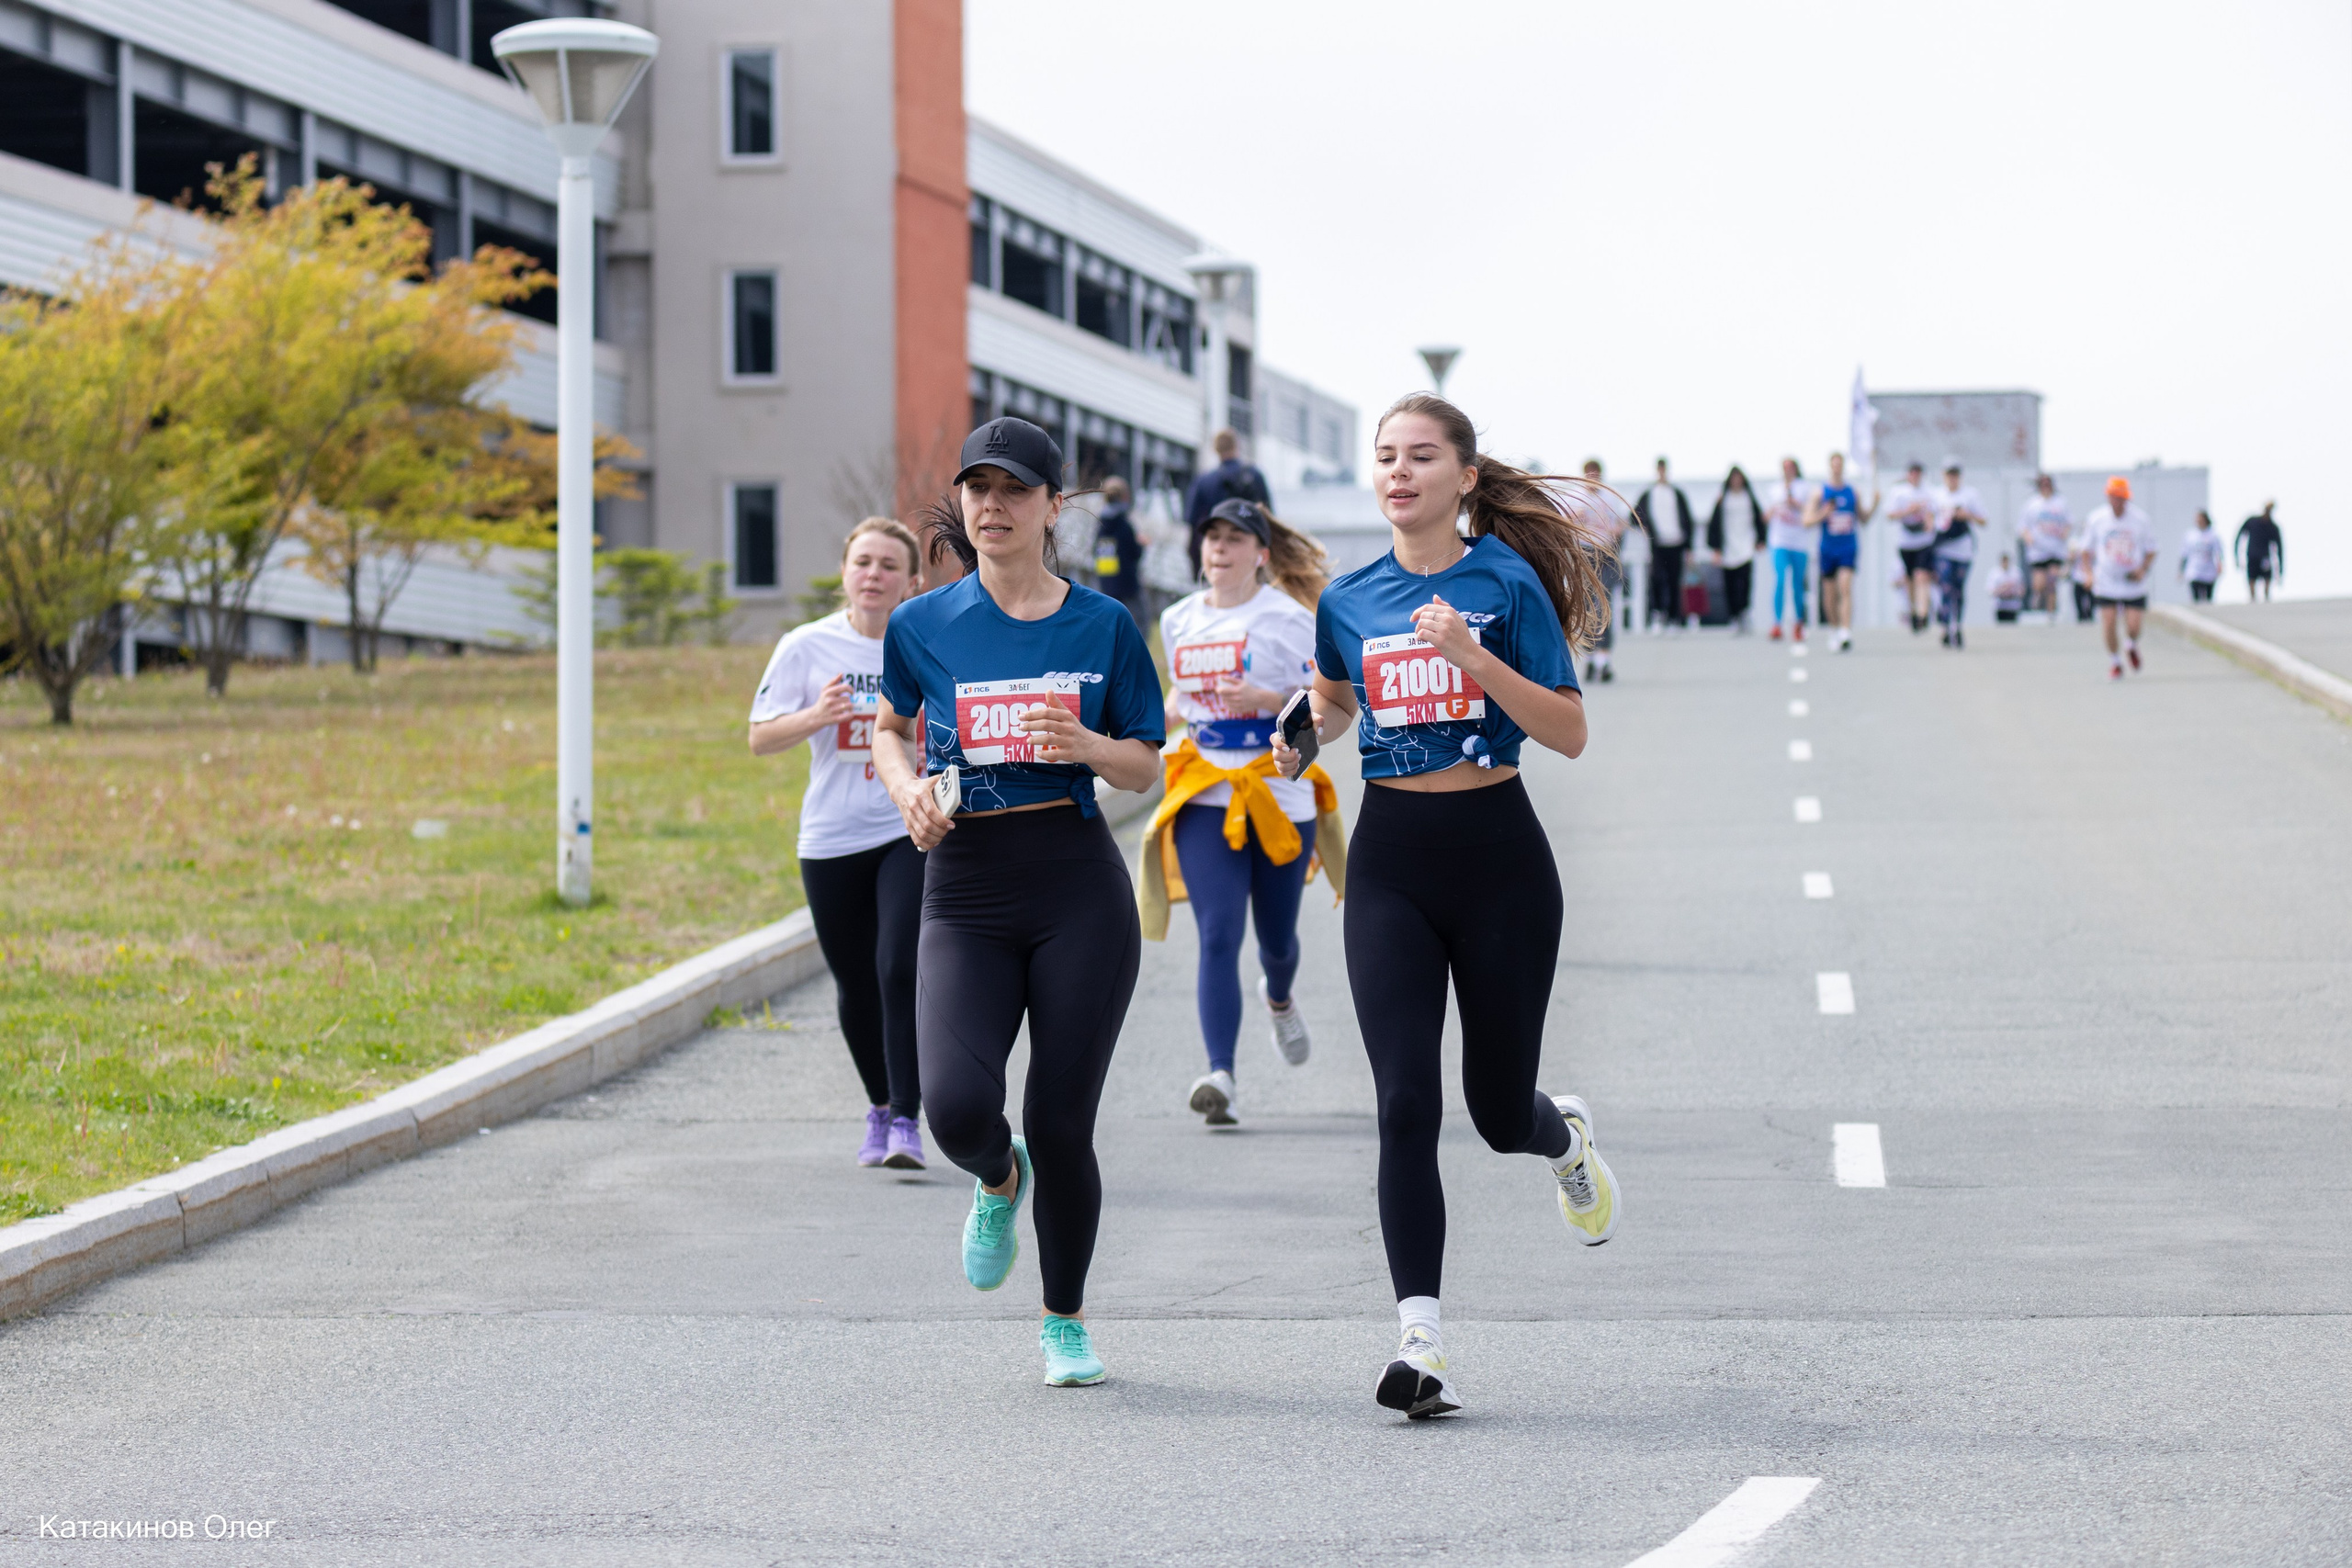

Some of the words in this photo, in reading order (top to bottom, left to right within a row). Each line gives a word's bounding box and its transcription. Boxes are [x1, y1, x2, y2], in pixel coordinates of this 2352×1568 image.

[985, 426, 1010, 457] LA
[1376, 640, 1391, 649] ПСБ
[1379, 656, 1464, 701] 21001
[1452, 698, 1464, 715] F
